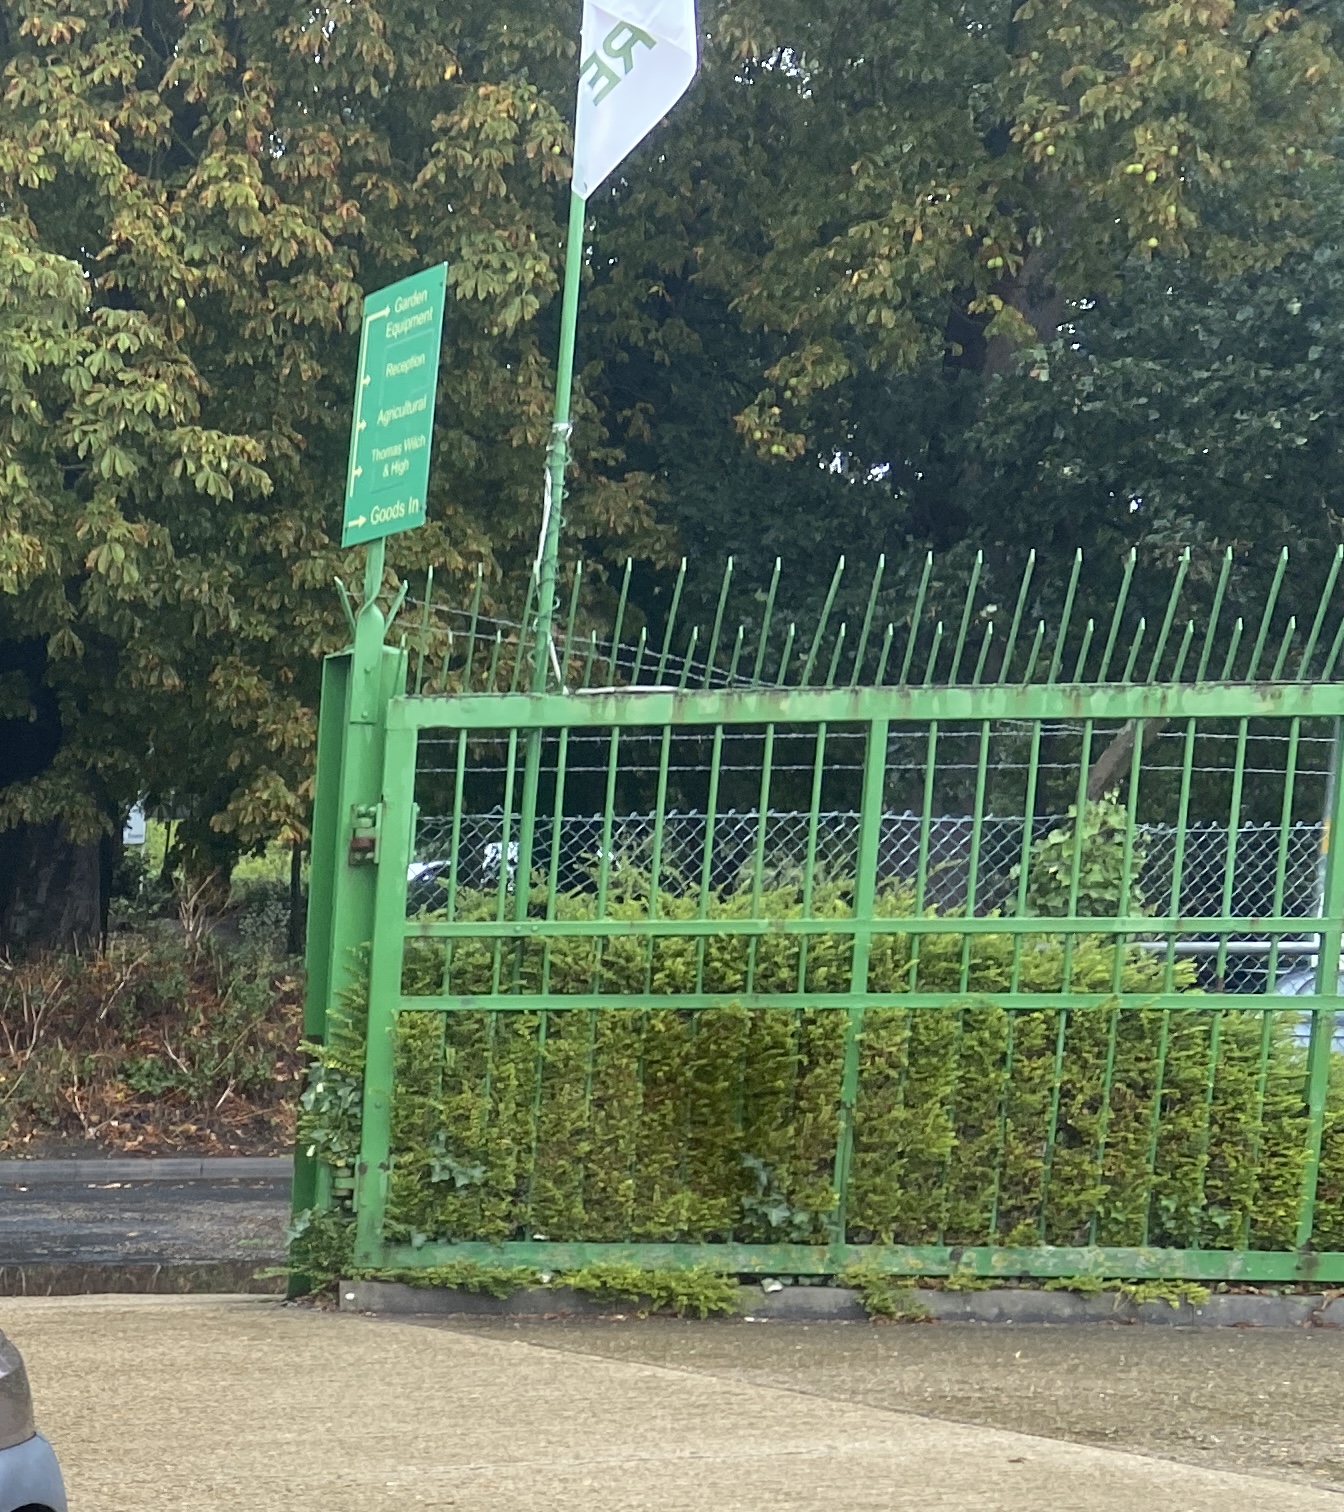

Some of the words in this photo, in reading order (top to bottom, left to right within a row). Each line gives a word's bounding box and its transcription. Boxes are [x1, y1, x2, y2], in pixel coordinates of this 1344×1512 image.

[394, 289, 428, 313] Garden
[385, 306, 433, 339] Equipment
[386, 352, 425, 378] Reception
[377, 394, 427, 426] Agricultural
[371, 499, 405, 525] Goods
[408, 496, 419, 514] In
